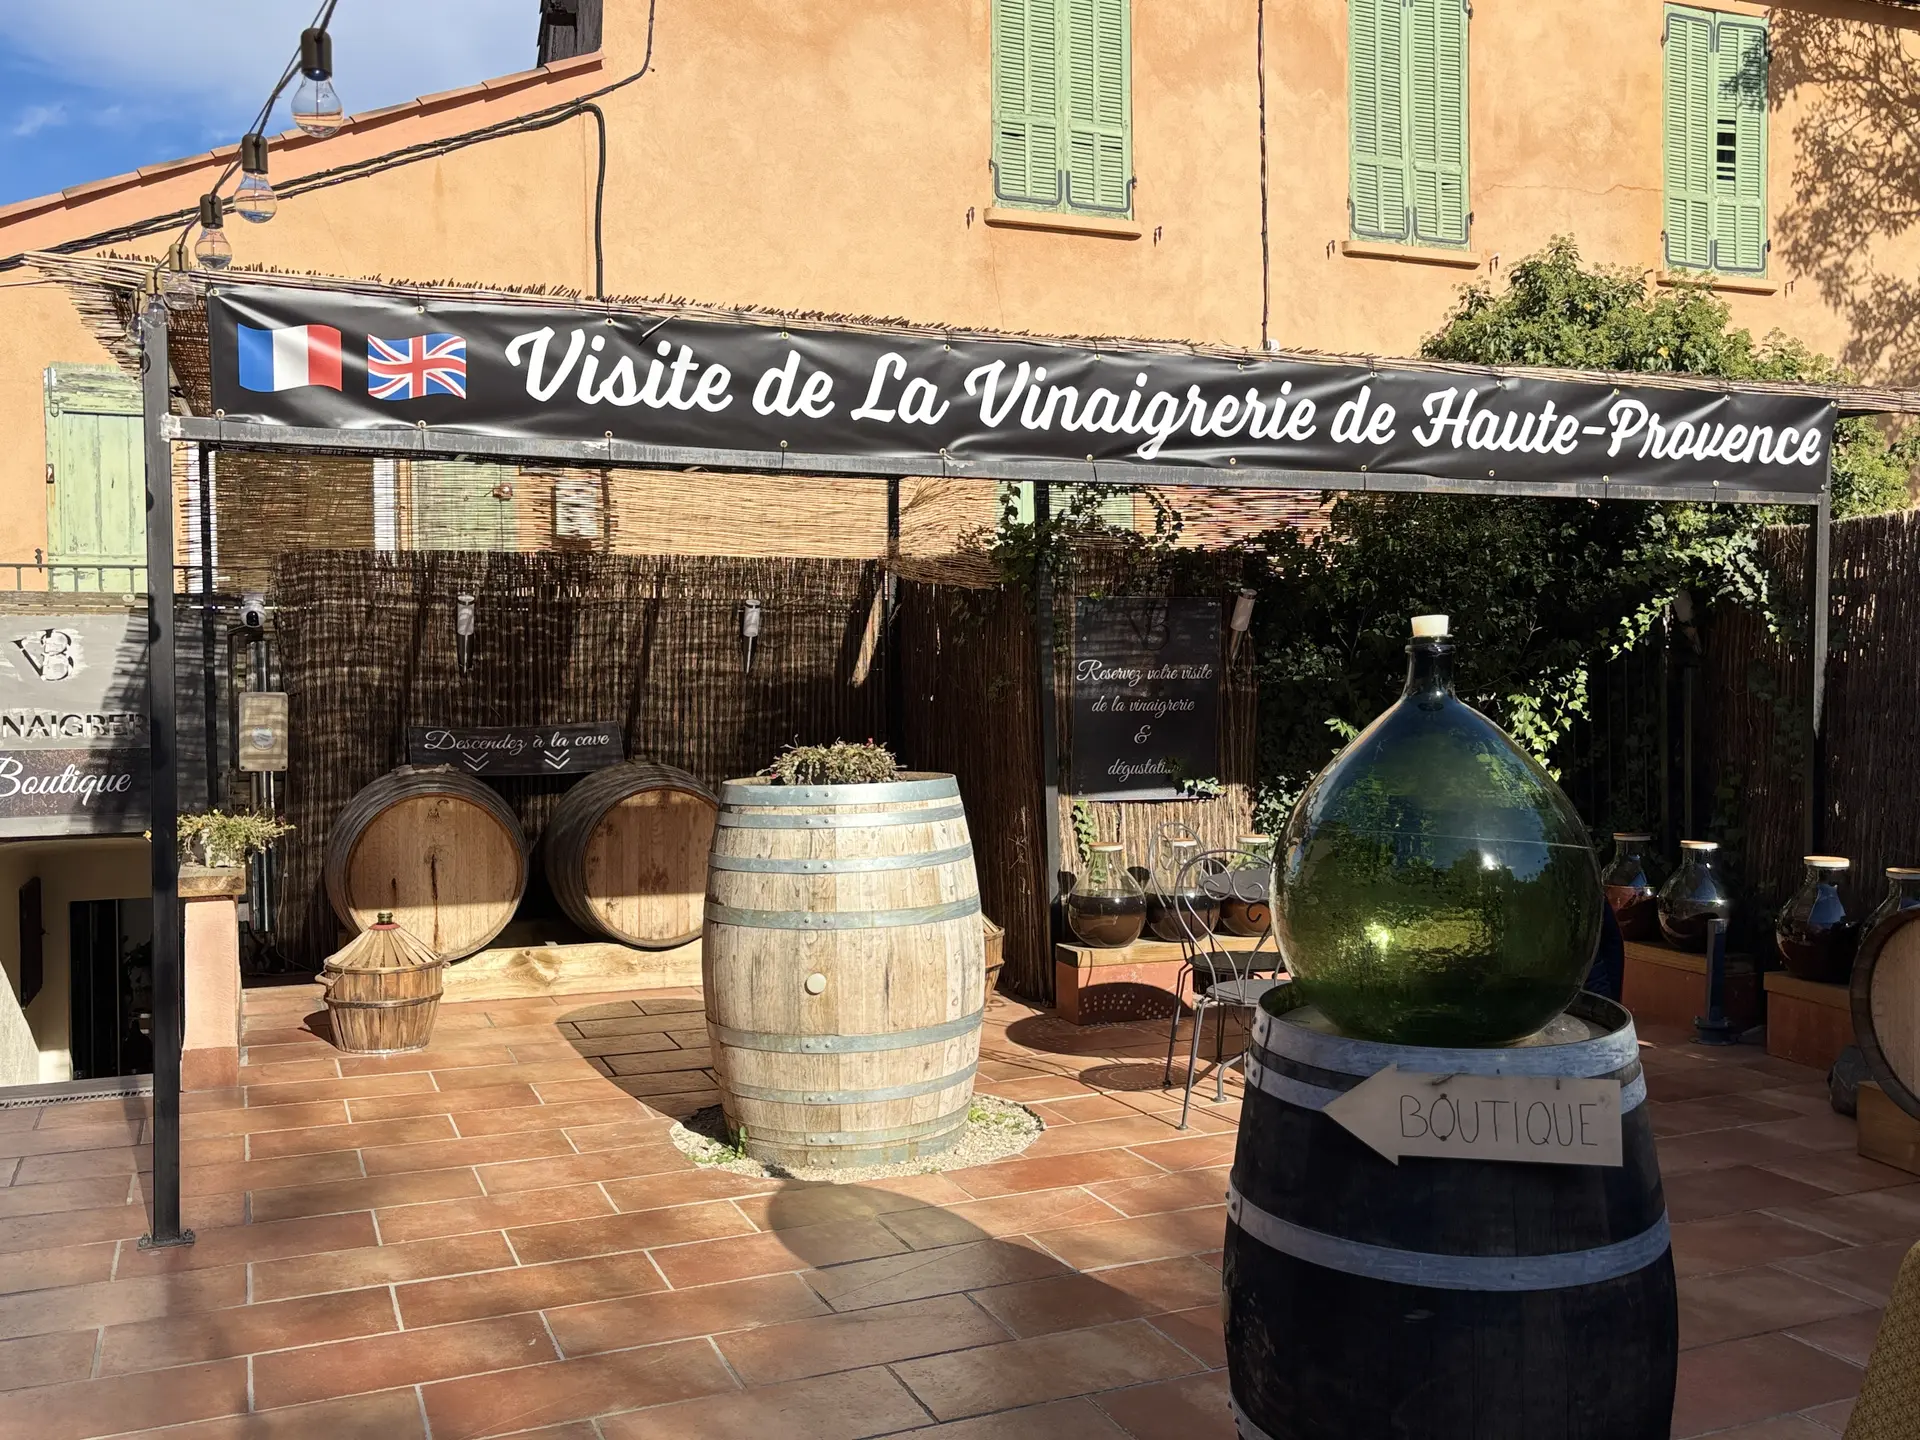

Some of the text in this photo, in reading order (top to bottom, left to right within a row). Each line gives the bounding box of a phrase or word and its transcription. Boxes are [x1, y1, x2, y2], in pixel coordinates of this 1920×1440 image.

[504, 325, 1821, 466] Visite de La Vinaigrerie de Haute-Provence
[1076, 659, 1213, 687] Reservez votre visite
[1091, 695, 1195, 719] de la vinaigrerie
[424, 730, 610, 756] Descendez à la cave
[1133, 724, 1152, 744] &
[0, 756, 132, 806] Boutique
[1400, 1094, 1598, 1147] BOUTIQUE
